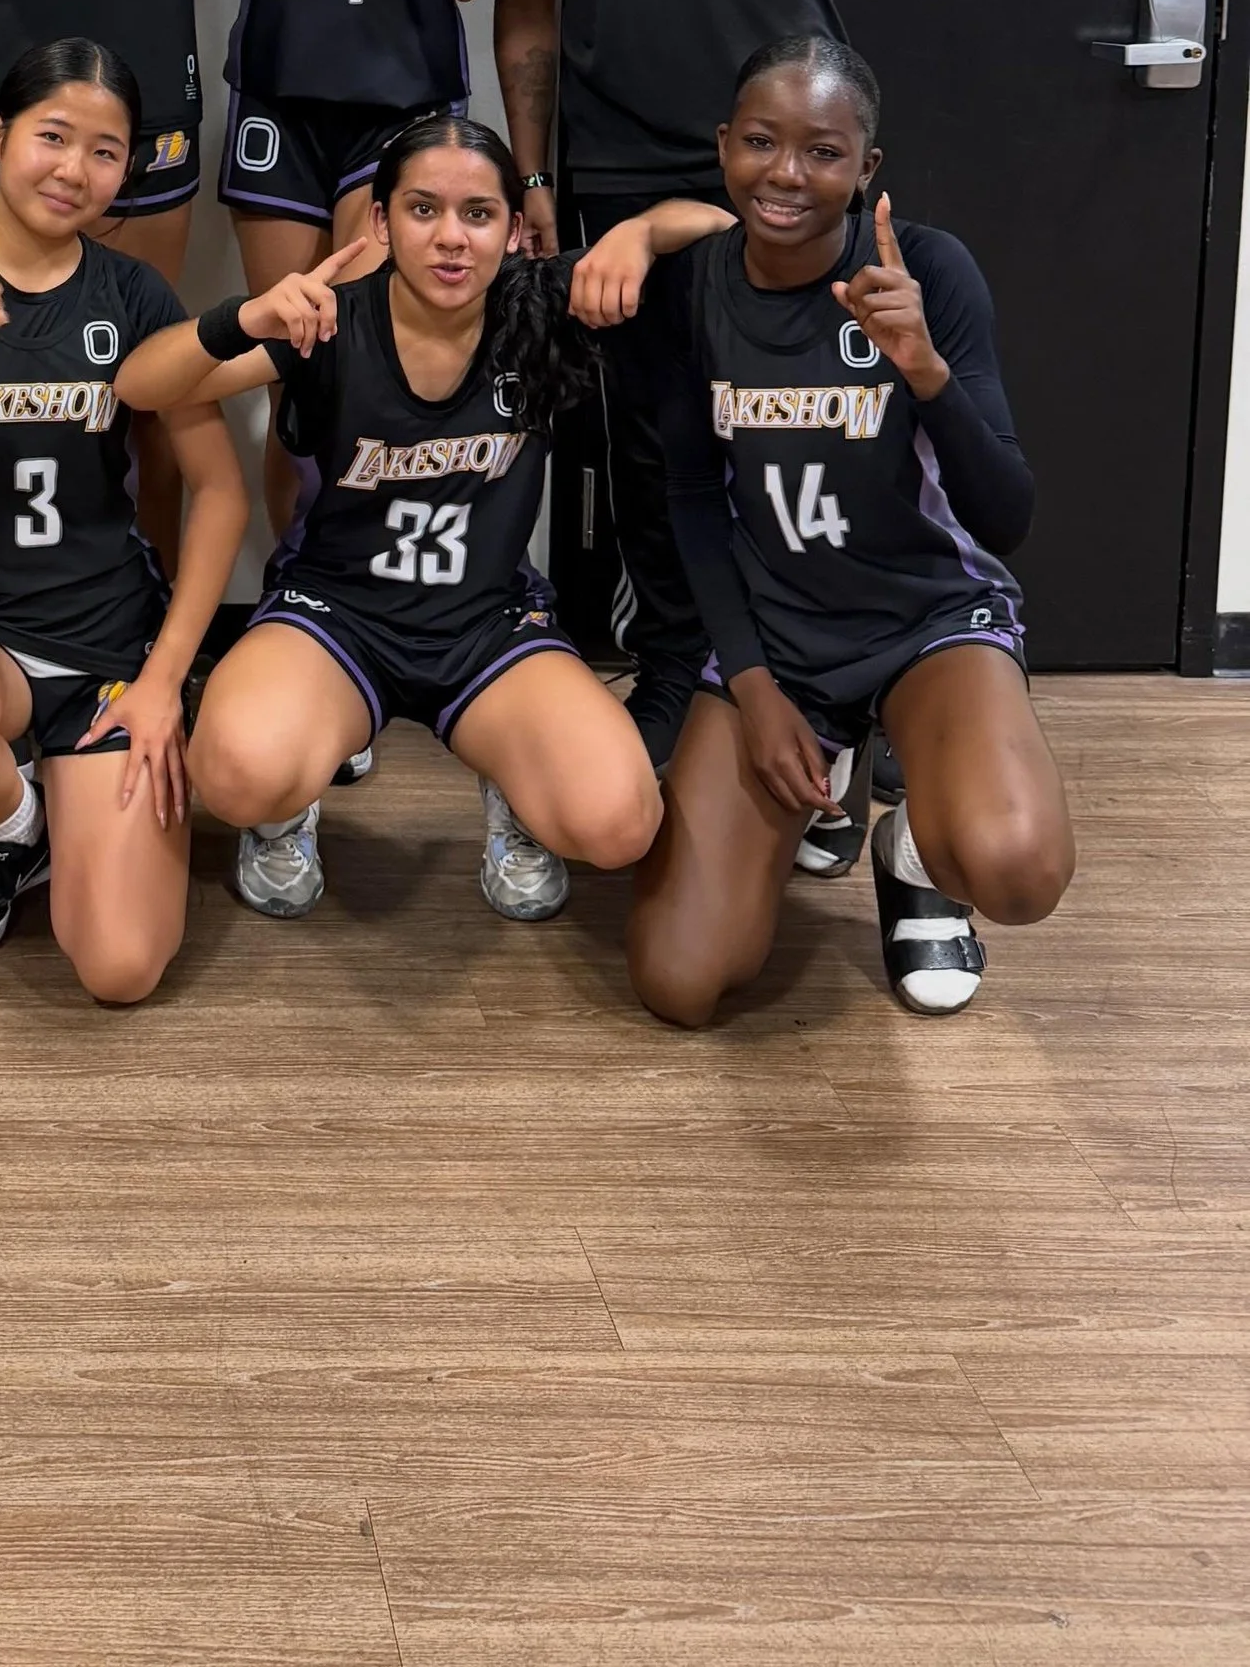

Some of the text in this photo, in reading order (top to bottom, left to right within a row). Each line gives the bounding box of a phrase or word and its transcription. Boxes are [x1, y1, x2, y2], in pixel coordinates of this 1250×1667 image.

[710, 380, 895, 441] LAKESHOW
[13, 456, 64, 549] 3
[336, 432, 529, 491] LAKESHOW
[368, 497, 473, 587] 33
[763, 462, 851, 554] 14
